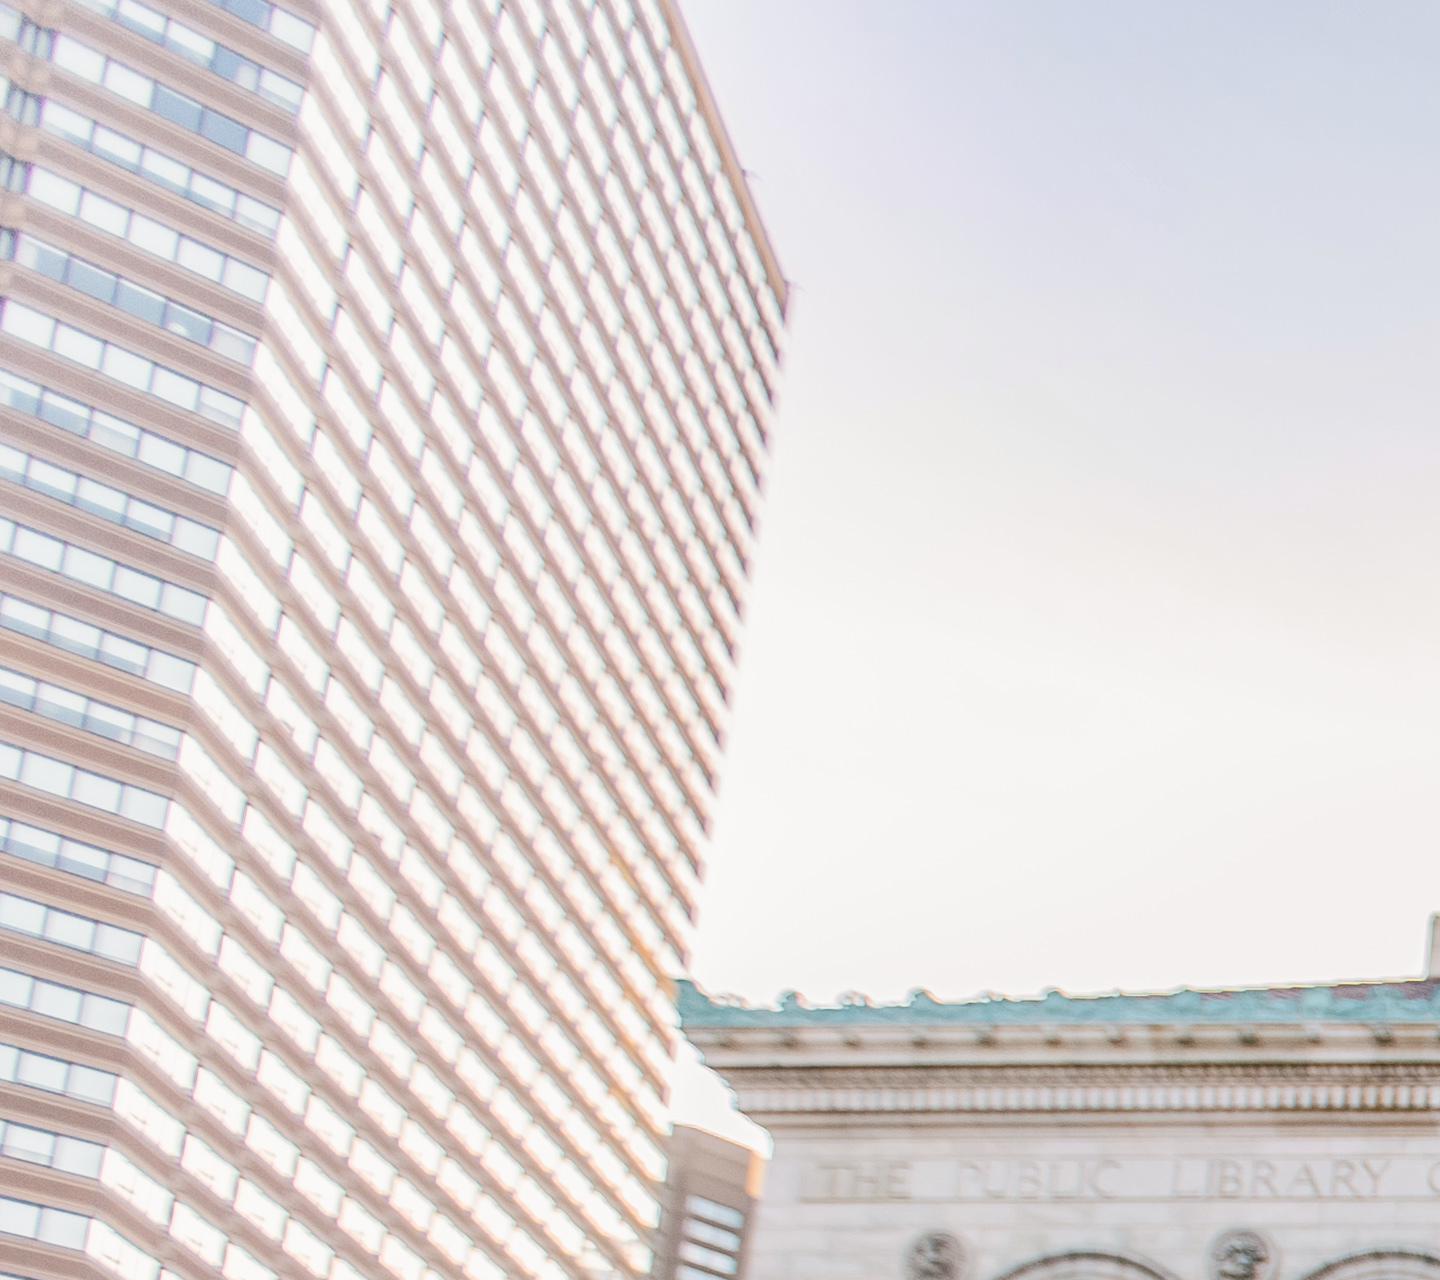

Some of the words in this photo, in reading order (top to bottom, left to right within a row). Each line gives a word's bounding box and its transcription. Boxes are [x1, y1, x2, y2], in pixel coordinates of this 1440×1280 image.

[817, 1160, 911, 1199] THE
[956, 1160, 1122, 1198] PUBLIC
[1172, 1159, 1391, 1197] LIBRARY
